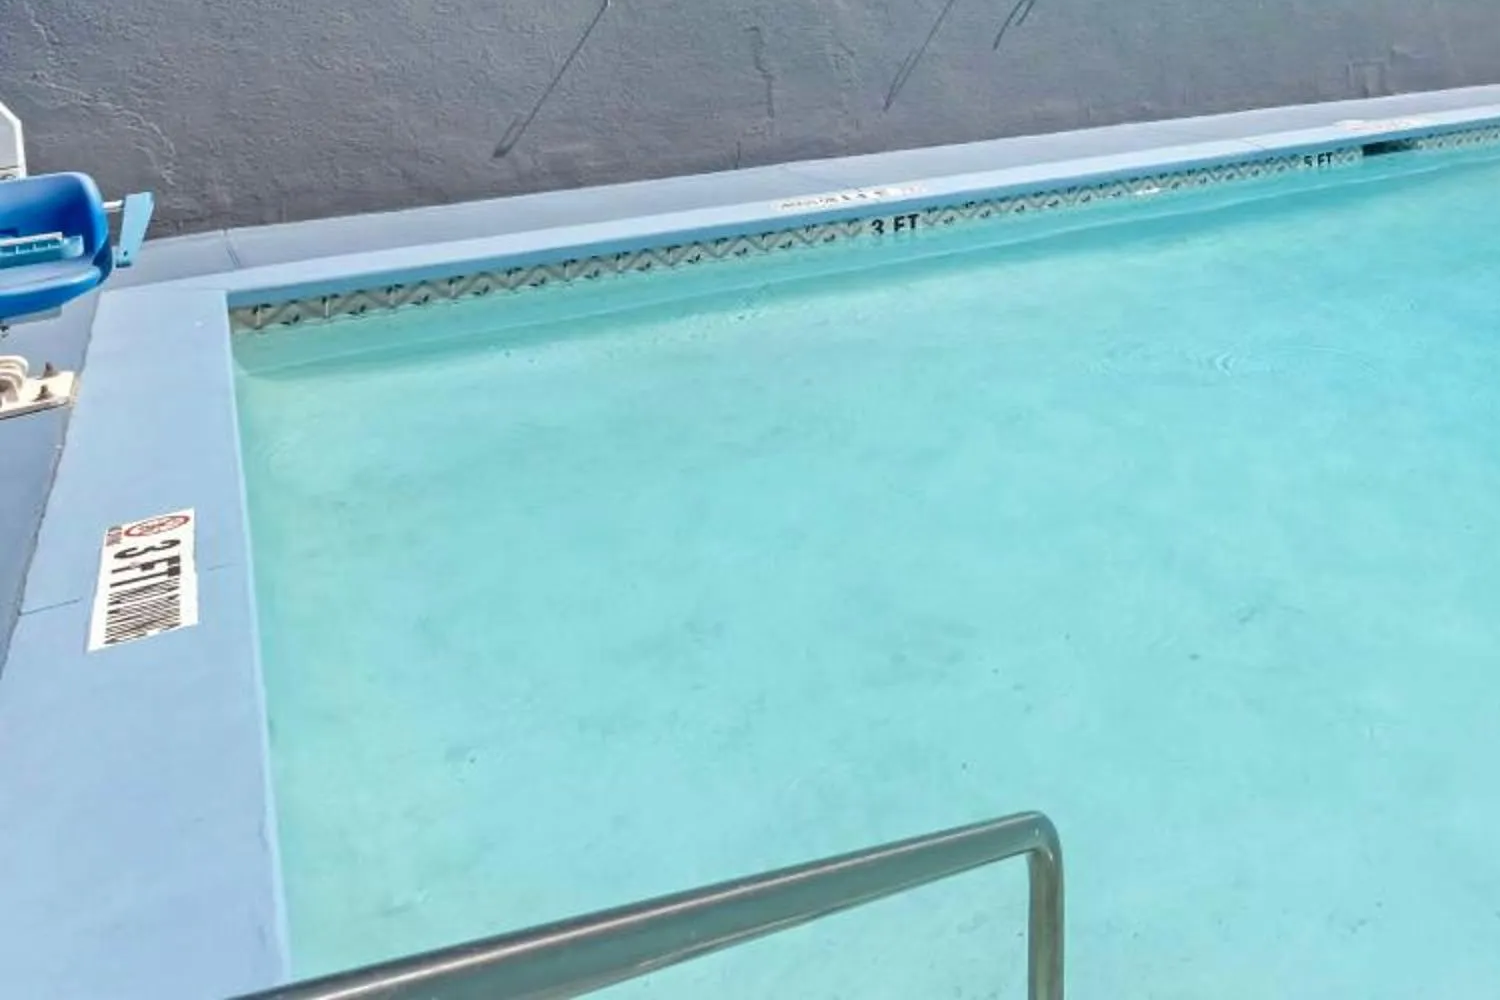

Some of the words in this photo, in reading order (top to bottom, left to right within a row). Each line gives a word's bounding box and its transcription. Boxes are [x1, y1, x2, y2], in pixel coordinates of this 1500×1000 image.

[870, 218, 885, 235] 3
[893, 213, 921, 233] FT
[114, 538, 182, 560] 3
[109, 555, 181, 589] FT
